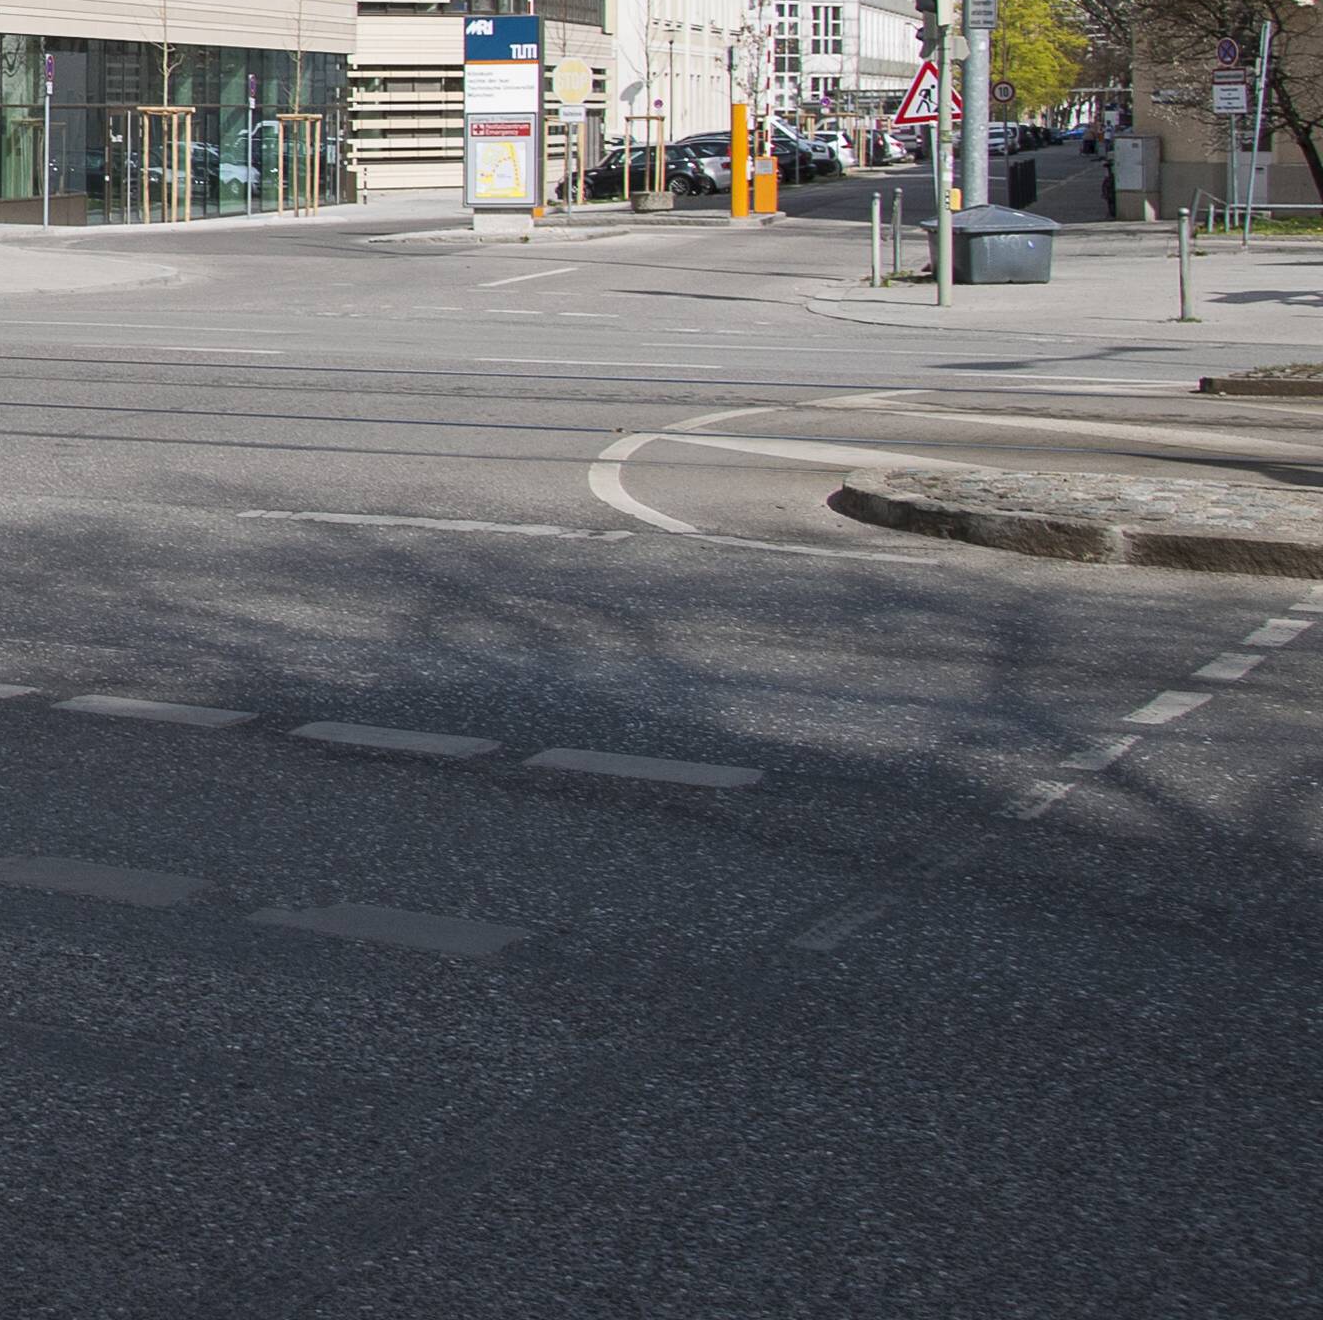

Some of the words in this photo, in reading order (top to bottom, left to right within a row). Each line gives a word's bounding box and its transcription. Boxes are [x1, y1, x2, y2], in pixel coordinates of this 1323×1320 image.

[465, 19, 494, 35] MRI
[509, 43, 538, 59] TUM
[997, 85, 1010, 98] 10
